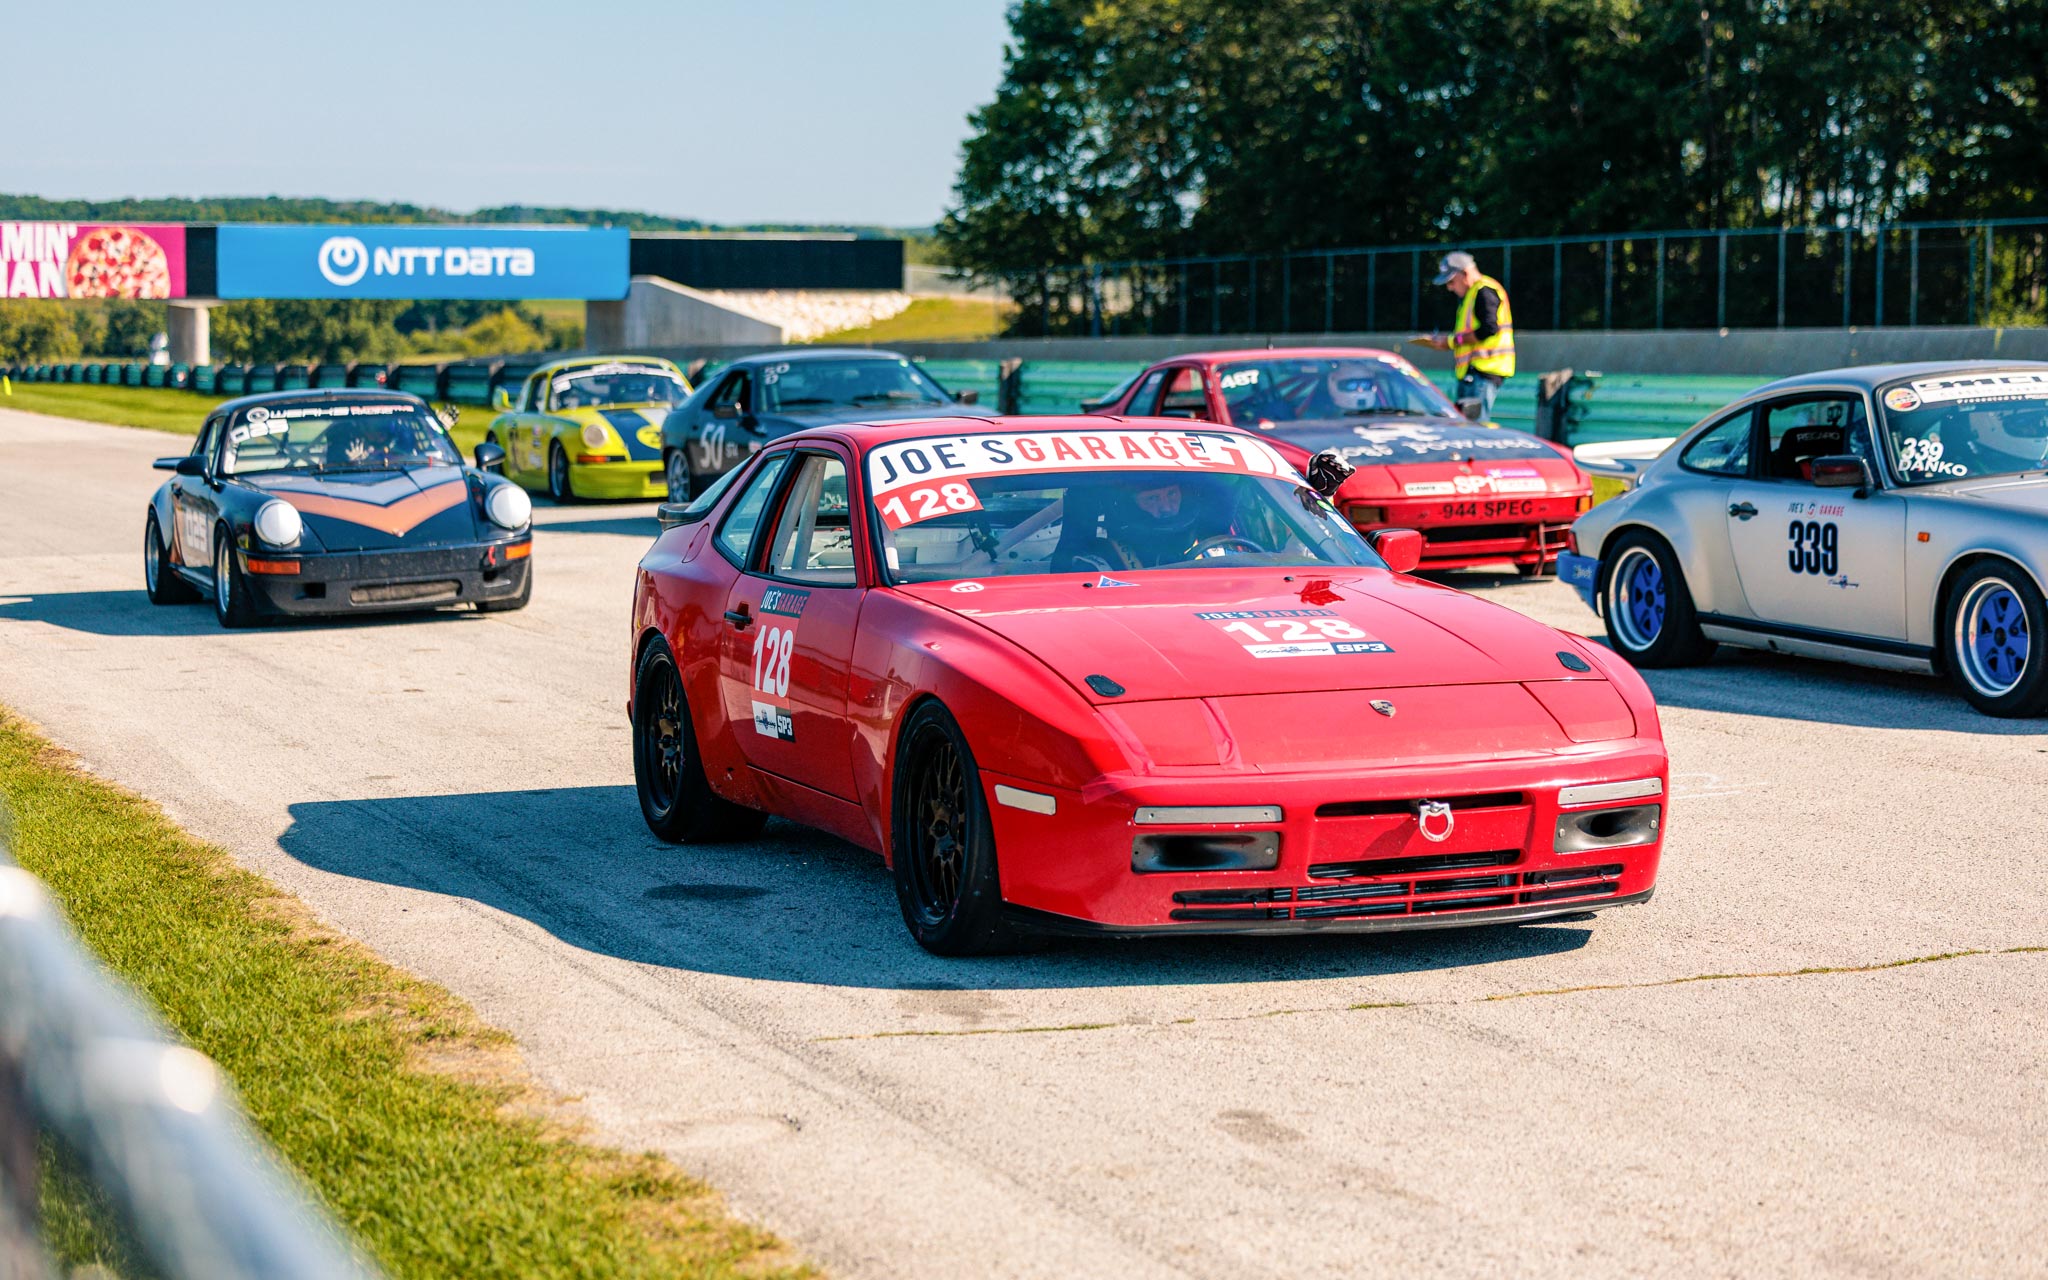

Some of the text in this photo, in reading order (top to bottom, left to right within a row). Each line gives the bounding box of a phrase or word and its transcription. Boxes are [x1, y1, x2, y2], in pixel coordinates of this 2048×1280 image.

[0, 223, 77, 262] MIN'
[374, 246, 442, 276] NTT
[701, 422, 725, 470] 50
[1901, 437, 1944, 462] 339
[1898, 458, 1968, 476] DANKO
[882, 483, 976, 525] 128
[1443, 500, 1533, 519] 944 SPEC
[1788, 519, 1838, 577] 339
[1223, 619, 1366, 642] 128
[753, 625, 793, 698] 128
[1335, 643, 1387, 653] SP3
[777, 715, 793, 736] SP3
